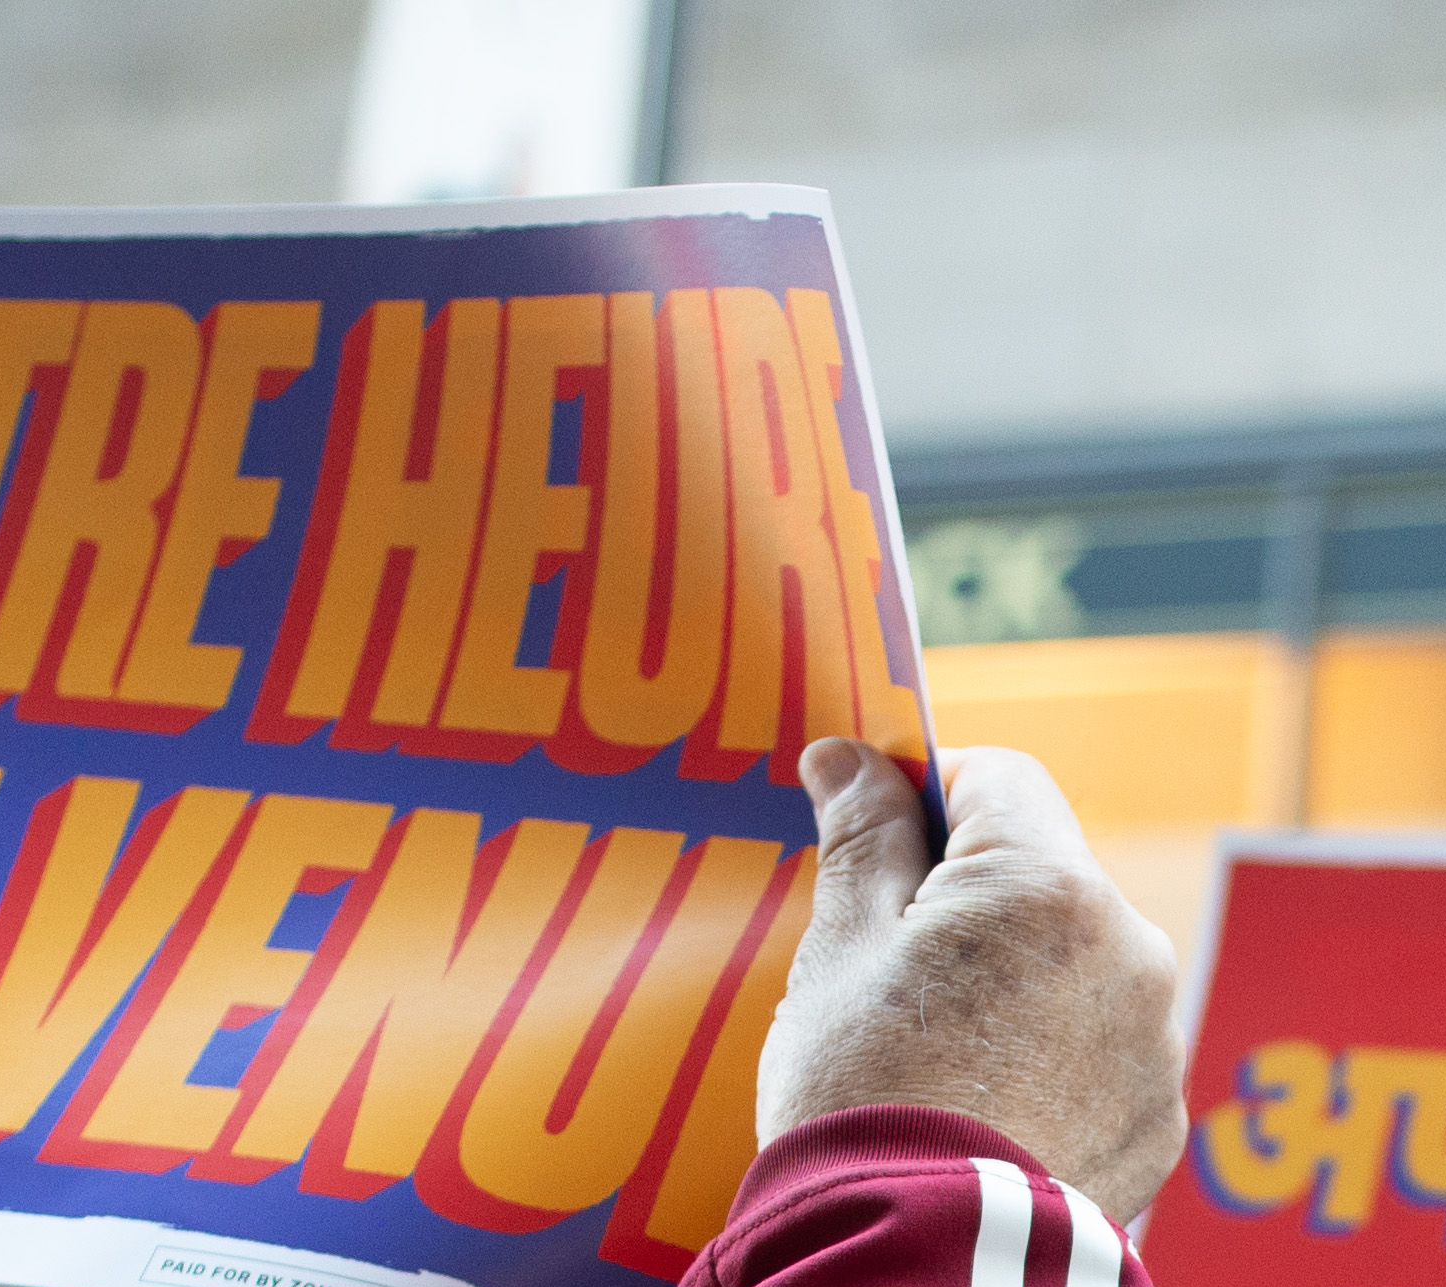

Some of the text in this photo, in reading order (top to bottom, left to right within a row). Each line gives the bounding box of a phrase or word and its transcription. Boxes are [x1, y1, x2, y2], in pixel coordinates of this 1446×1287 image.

[244, 284, 928, 792] HEURE
[160, 1258, 206, 1277] PAID
[210, 1265, 252, 1285] FOR
